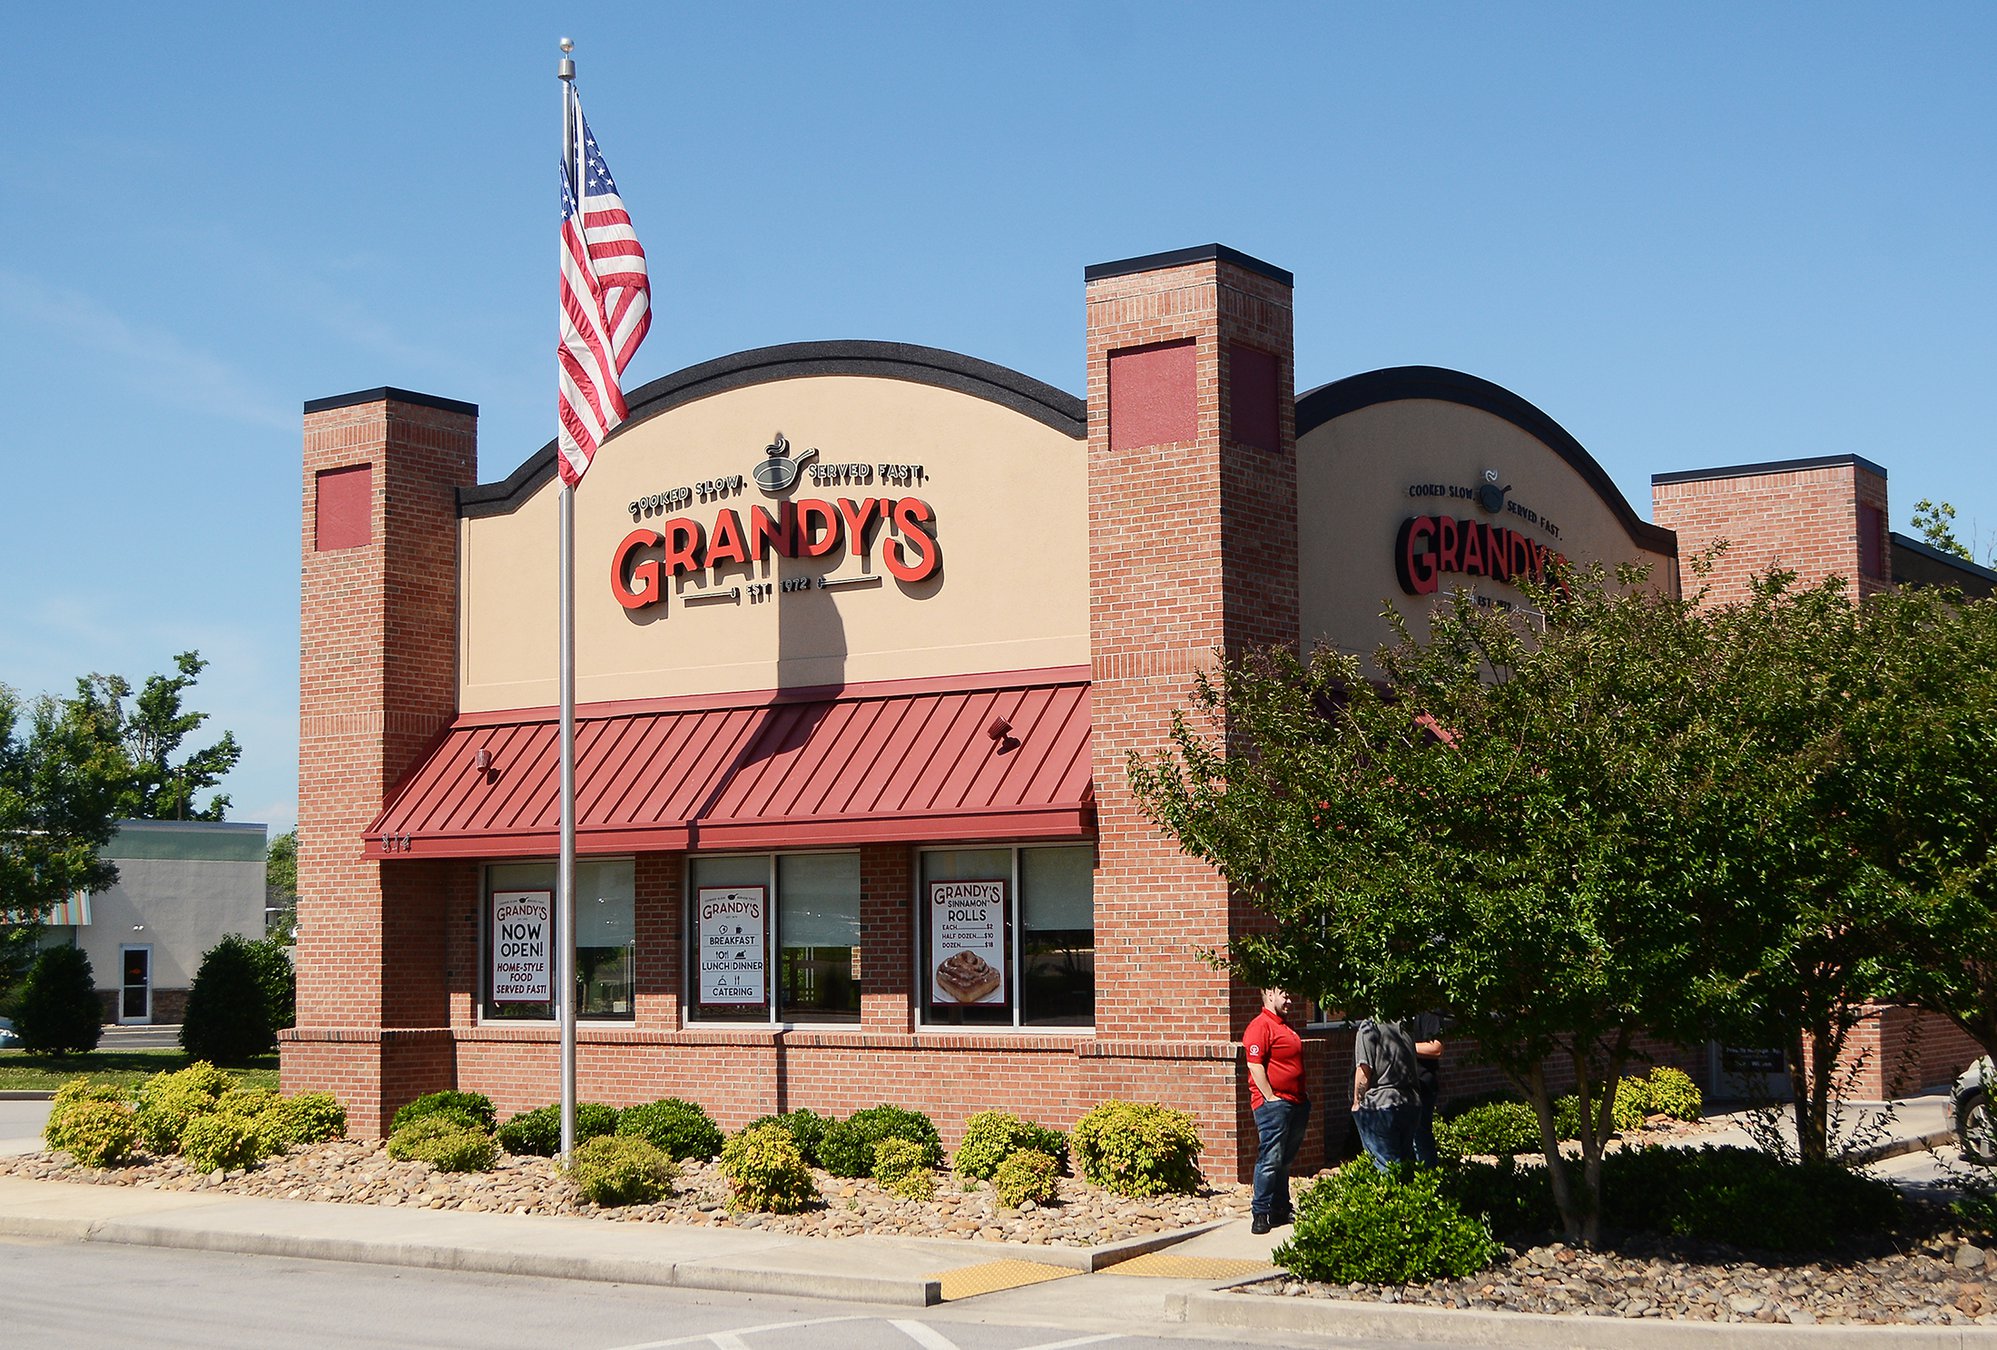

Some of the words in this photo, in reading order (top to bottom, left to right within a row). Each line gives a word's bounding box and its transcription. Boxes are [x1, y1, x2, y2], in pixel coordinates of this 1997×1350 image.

[809, 464, 871, 478] SERVED
[1409, 484, 1445, 497] COOKED
[628, 487, 690, 514] COOKED
[1507, 500, 1537, 523] SERVED
[611, 497, 937, 609] GRANDY'S
[1396, 515, 1571, 604] GRANDY
[780, 577, 809, 592] 1972
[382, 832, 411, 850] 814
[934, 885, 1001, 905] GRANDY'S
[497, 905, 547, 921] GRANDY'S
[702, 902, 760, 920] GRANDY'S
[948, 910, 987, 921] ROLLS
[502, 923, 542, 940] NOW
[709, 936, 755, 945] BREAKFAST
[500, 941, 544, 957] OPEN!
[497, 963, 544, 972] HOME-STYLE
[510, 973, 533, 982] FOOD
[496, 984, 525, 994] SERVED
[526, 984, 547, 993] FAST!
[712, 988, 753, 996] CATERING
